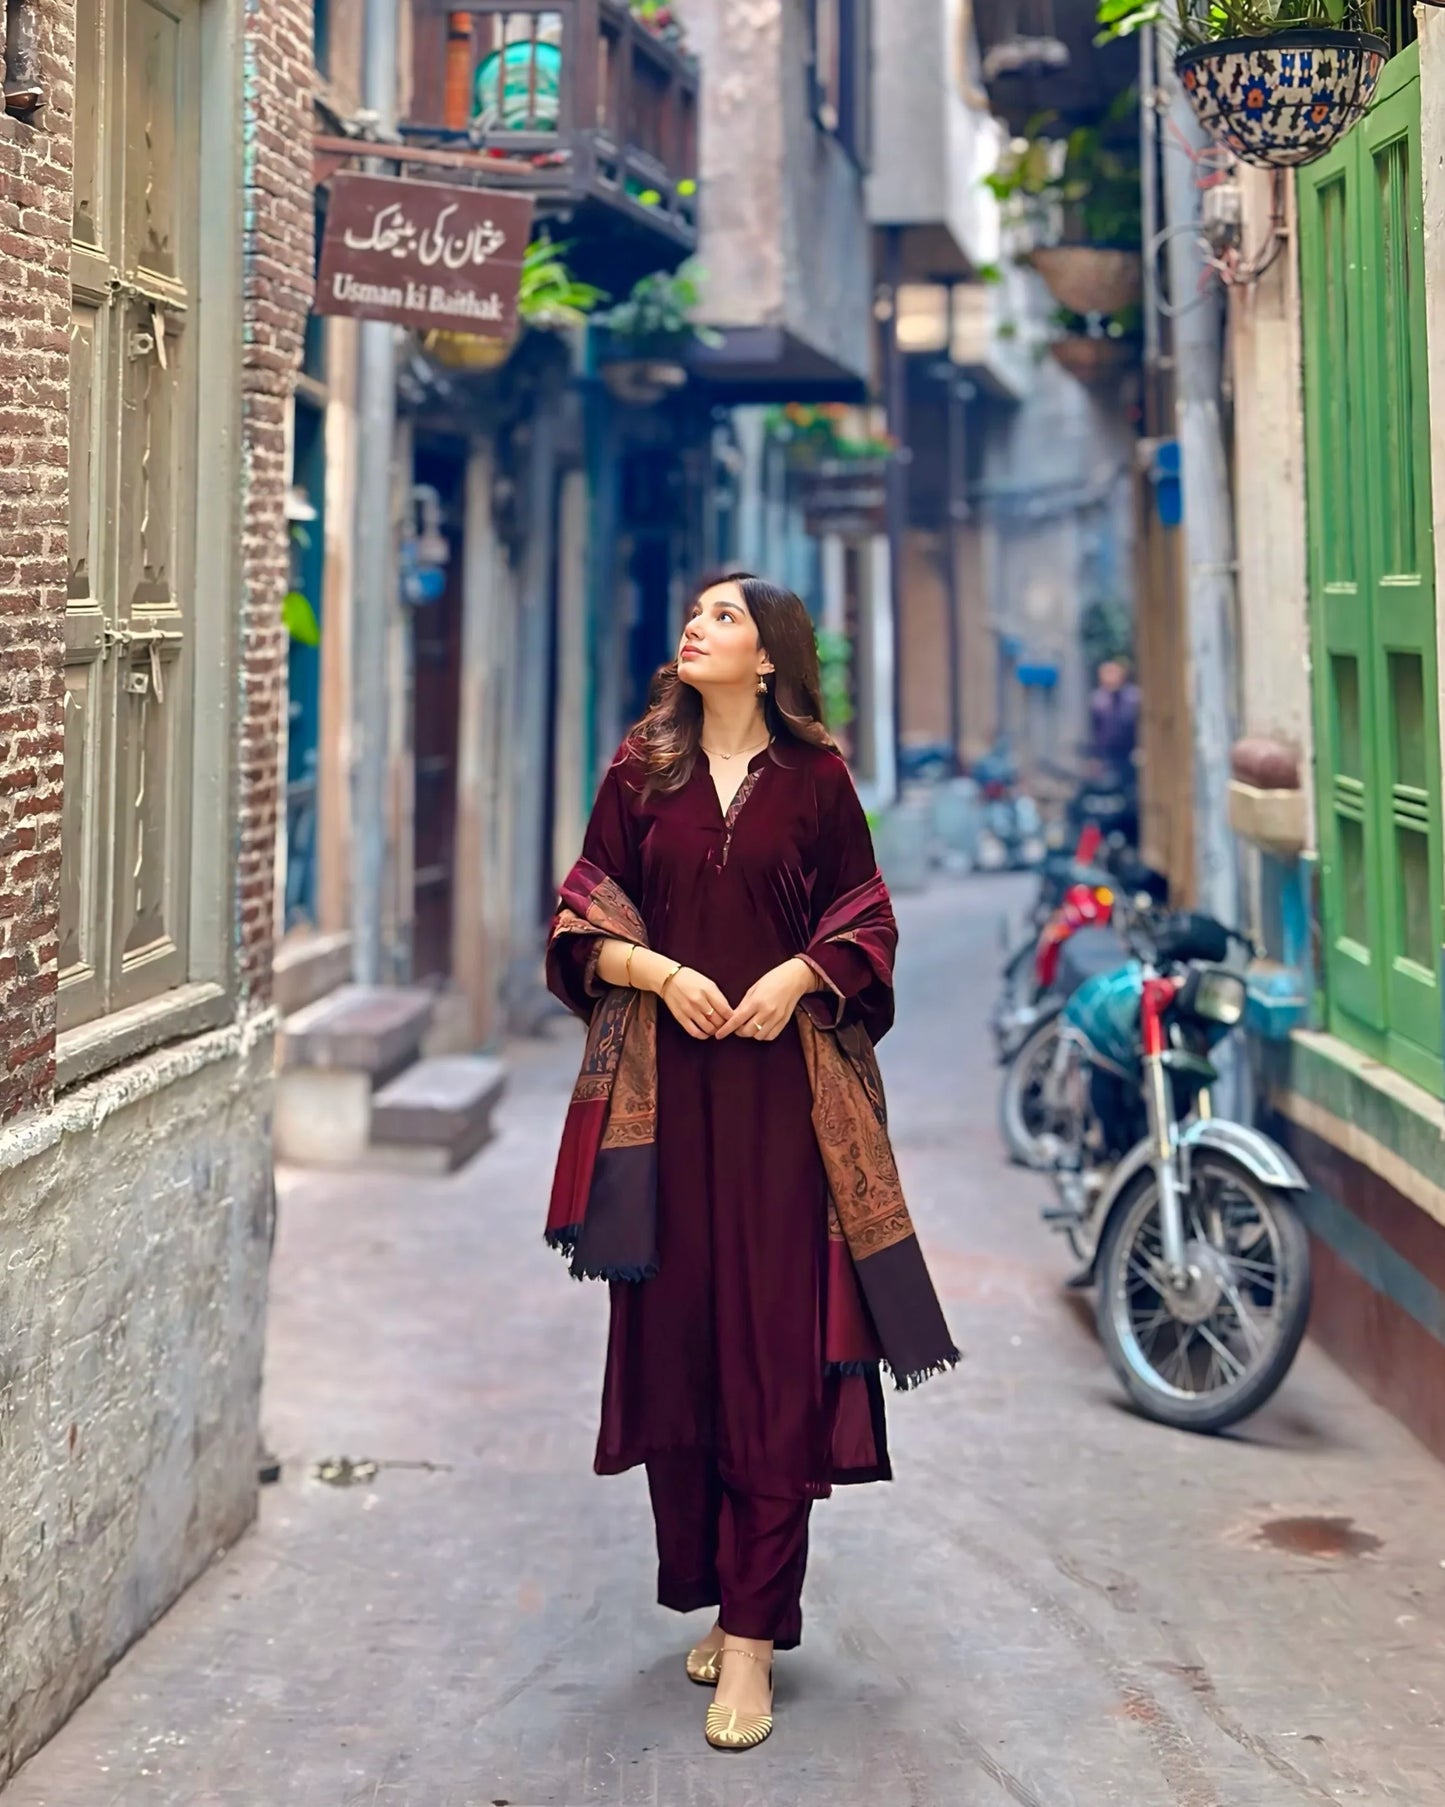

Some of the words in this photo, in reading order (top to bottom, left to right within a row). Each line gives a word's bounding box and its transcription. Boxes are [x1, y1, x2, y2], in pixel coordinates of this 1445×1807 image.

[418, 203, 459, 267] کی
[333, 272, 403, 308] Usman
[405, 282, 427, 311] ki
[429, 285, 504, 322] Baithak
